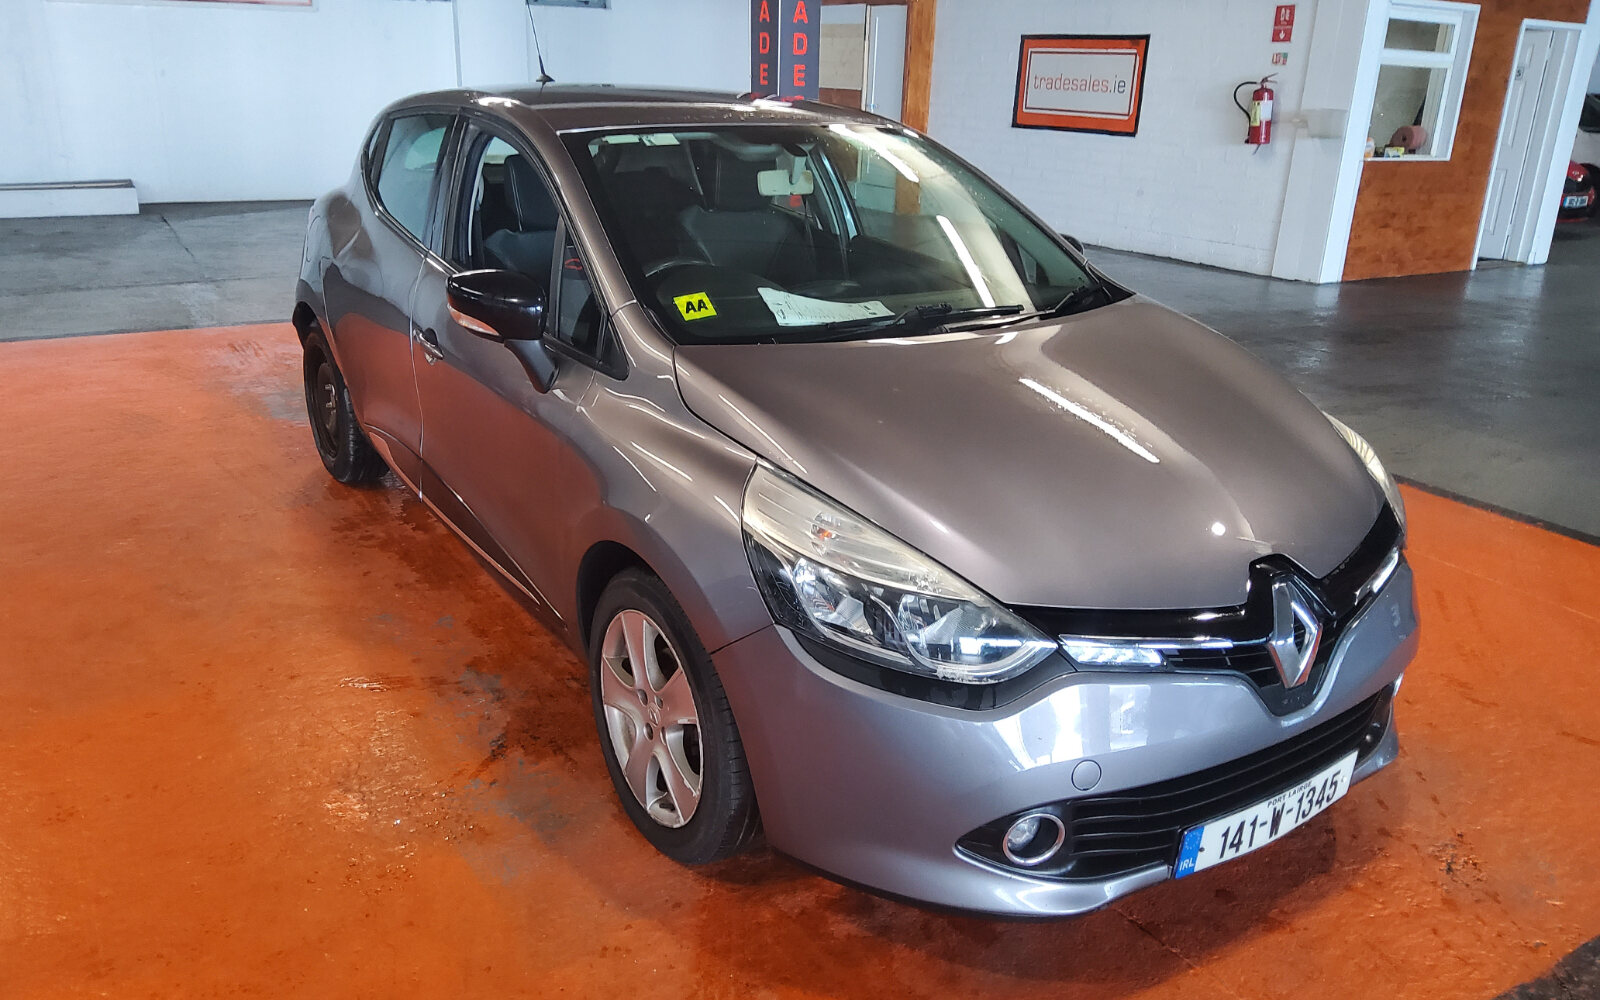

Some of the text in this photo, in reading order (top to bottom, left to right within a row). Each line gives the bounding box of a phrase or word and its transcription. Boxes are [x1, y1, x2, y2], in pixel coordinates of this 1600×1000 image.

[793, 0, 808, 100] ADE
[1034, 73, 1127, 94] tradesales.ie
[685, 299, 708, 314] AA
[1267, 794, 1286, 808] PORT
[1219, 769, 1341, 859] 141-W-1345
[1179, 858, 1195, 871] IRL
